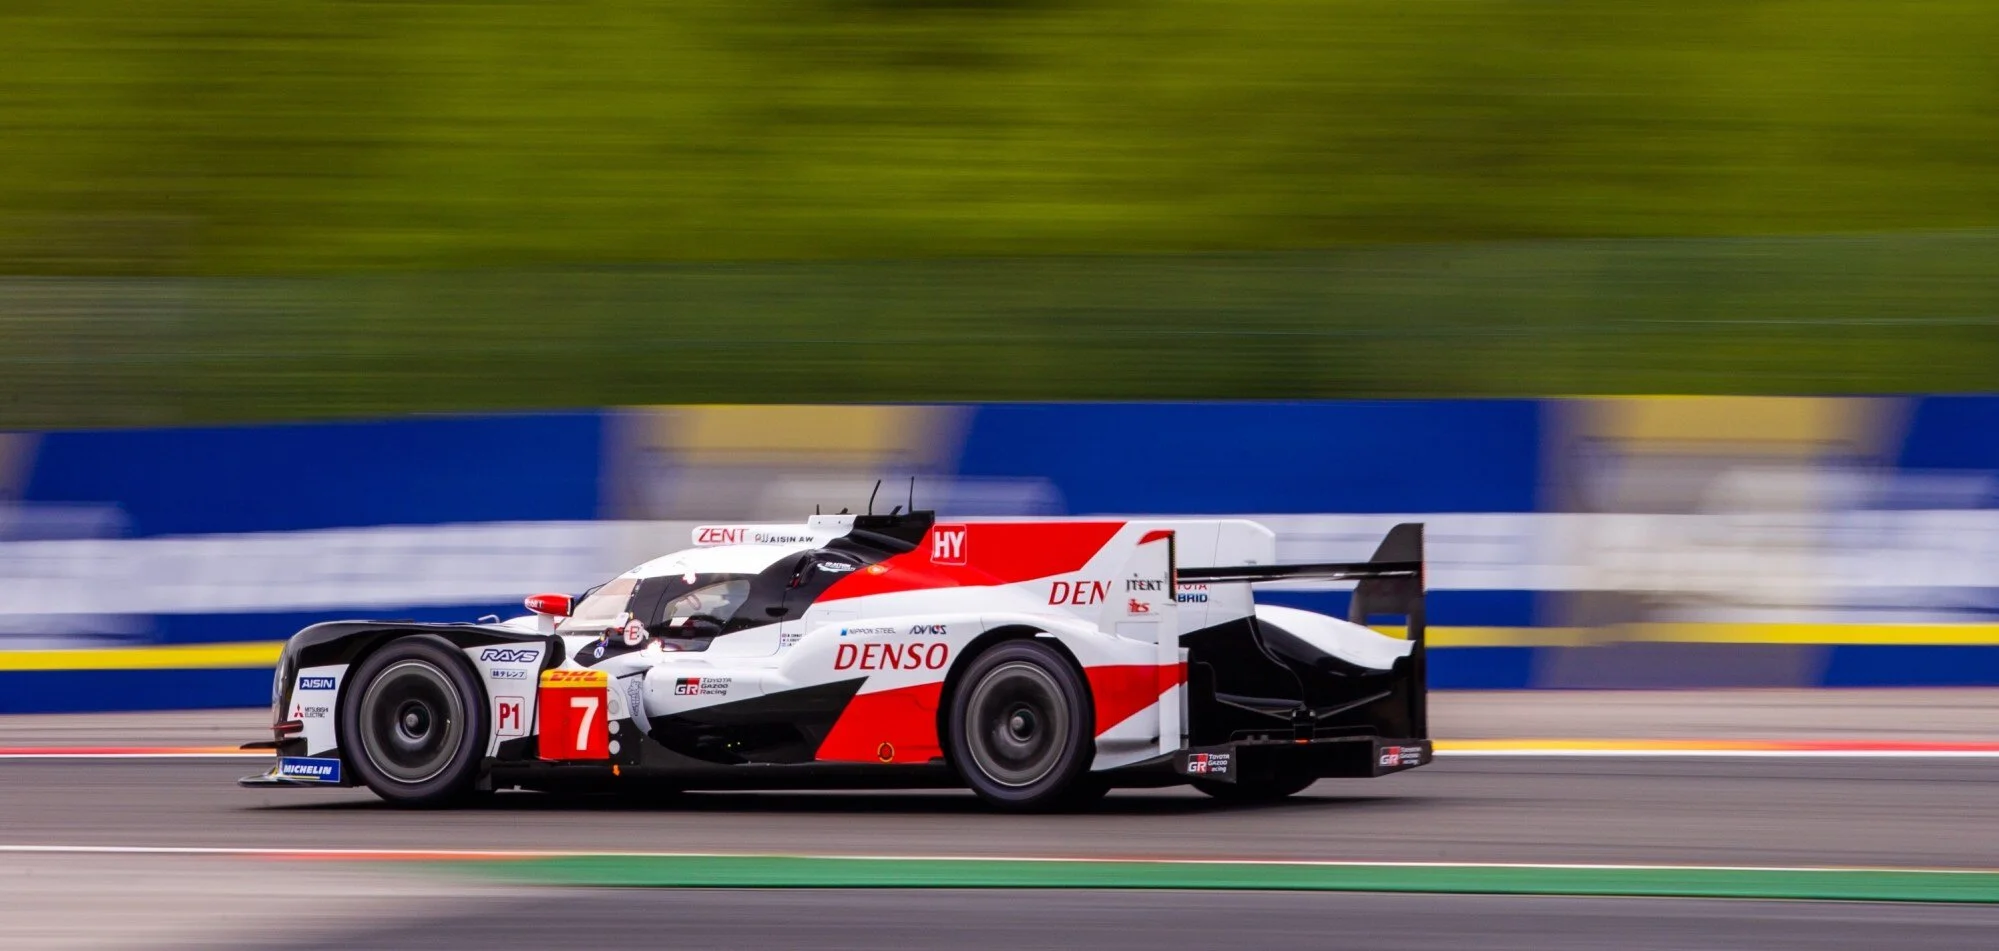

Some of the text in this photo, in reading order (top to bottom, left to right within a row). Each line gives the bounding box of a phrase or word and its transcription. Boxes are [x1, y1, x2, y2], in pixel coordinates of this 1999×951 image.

[698, 528, 748, 543] ZENT
[933, 531, 965, 558] HY
[481, 649, 540, 663] RAYS
[834, 643, 949, 670] DENSO
[301, 679, 333, 689] AISIN
[675, 684, 698, 695] GR
[499, 703, 520, 729] P1
[570, 696, 599, 750] 7
[283, 764, 333, 775] MICHELIN
[1188, 761, 1207, 773] GR
